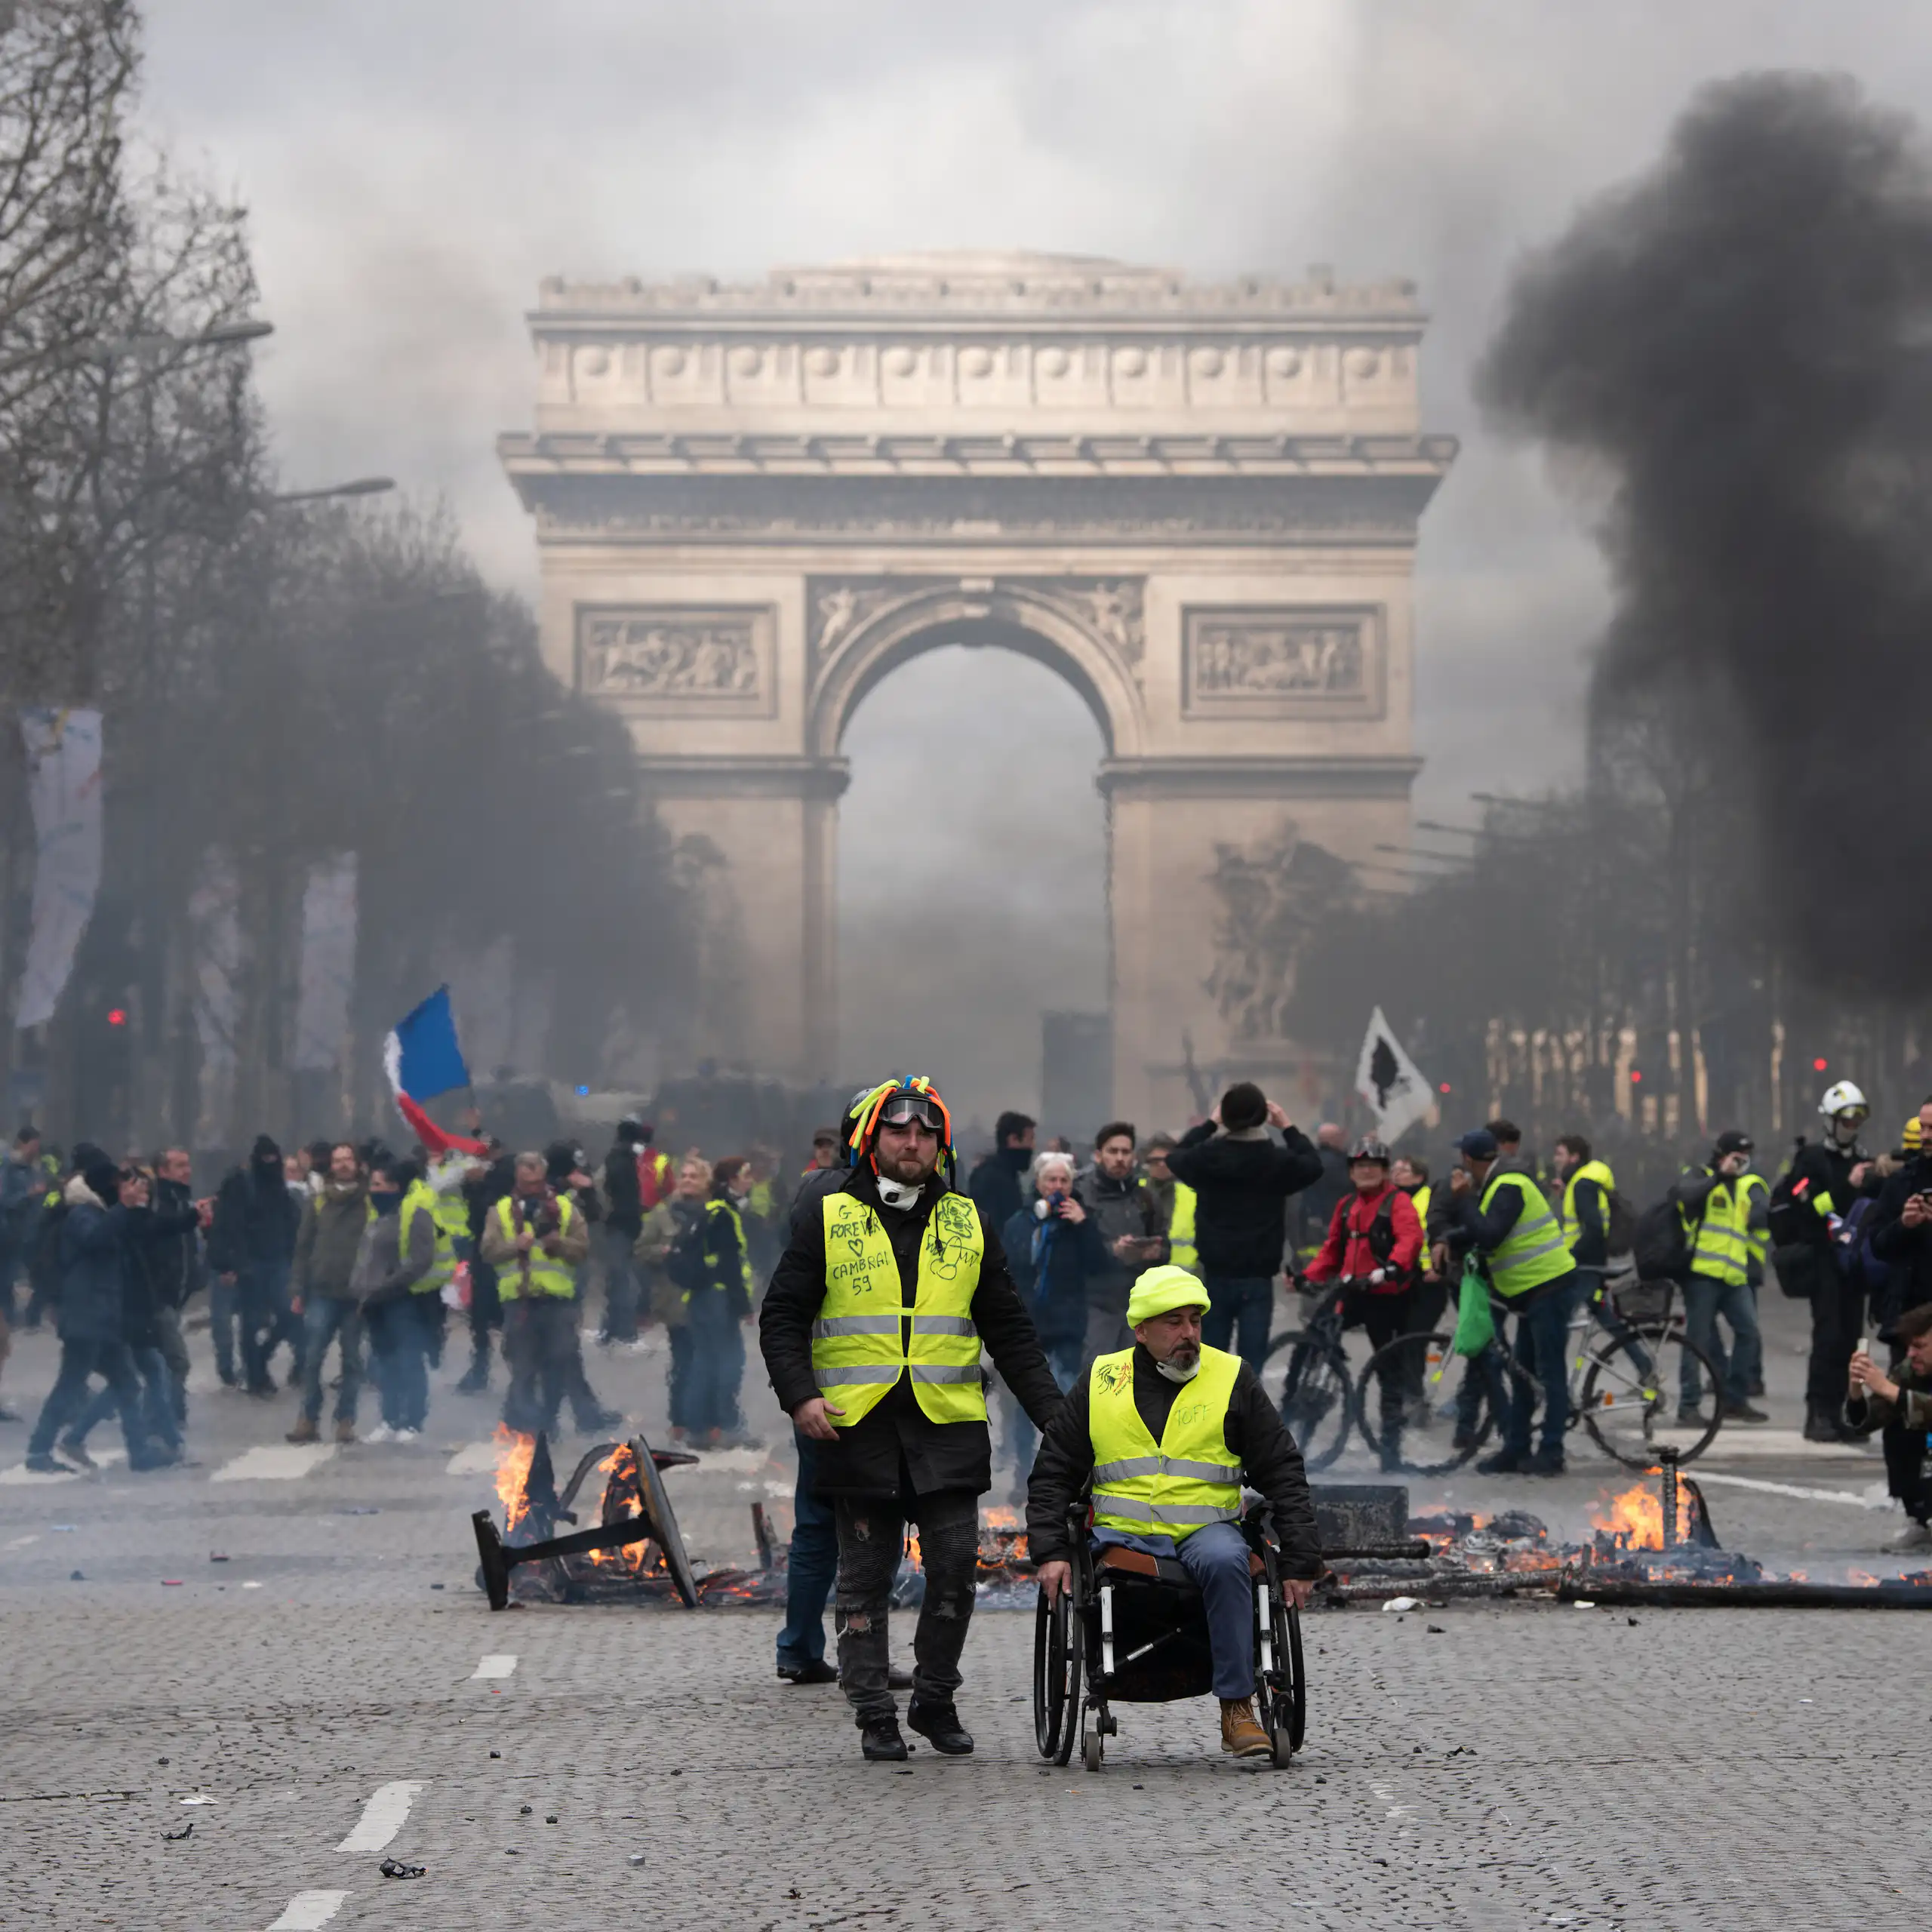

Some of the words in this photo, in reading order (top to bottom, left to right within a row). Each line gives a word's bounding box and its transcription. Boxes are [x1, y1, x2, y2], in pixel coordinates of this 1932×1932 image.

[832, 1251, 888, 1279] CAMBRAI
[852, 1275, 872, 1296] 59
[1174, 1401, 1215, 1426] TOFF
